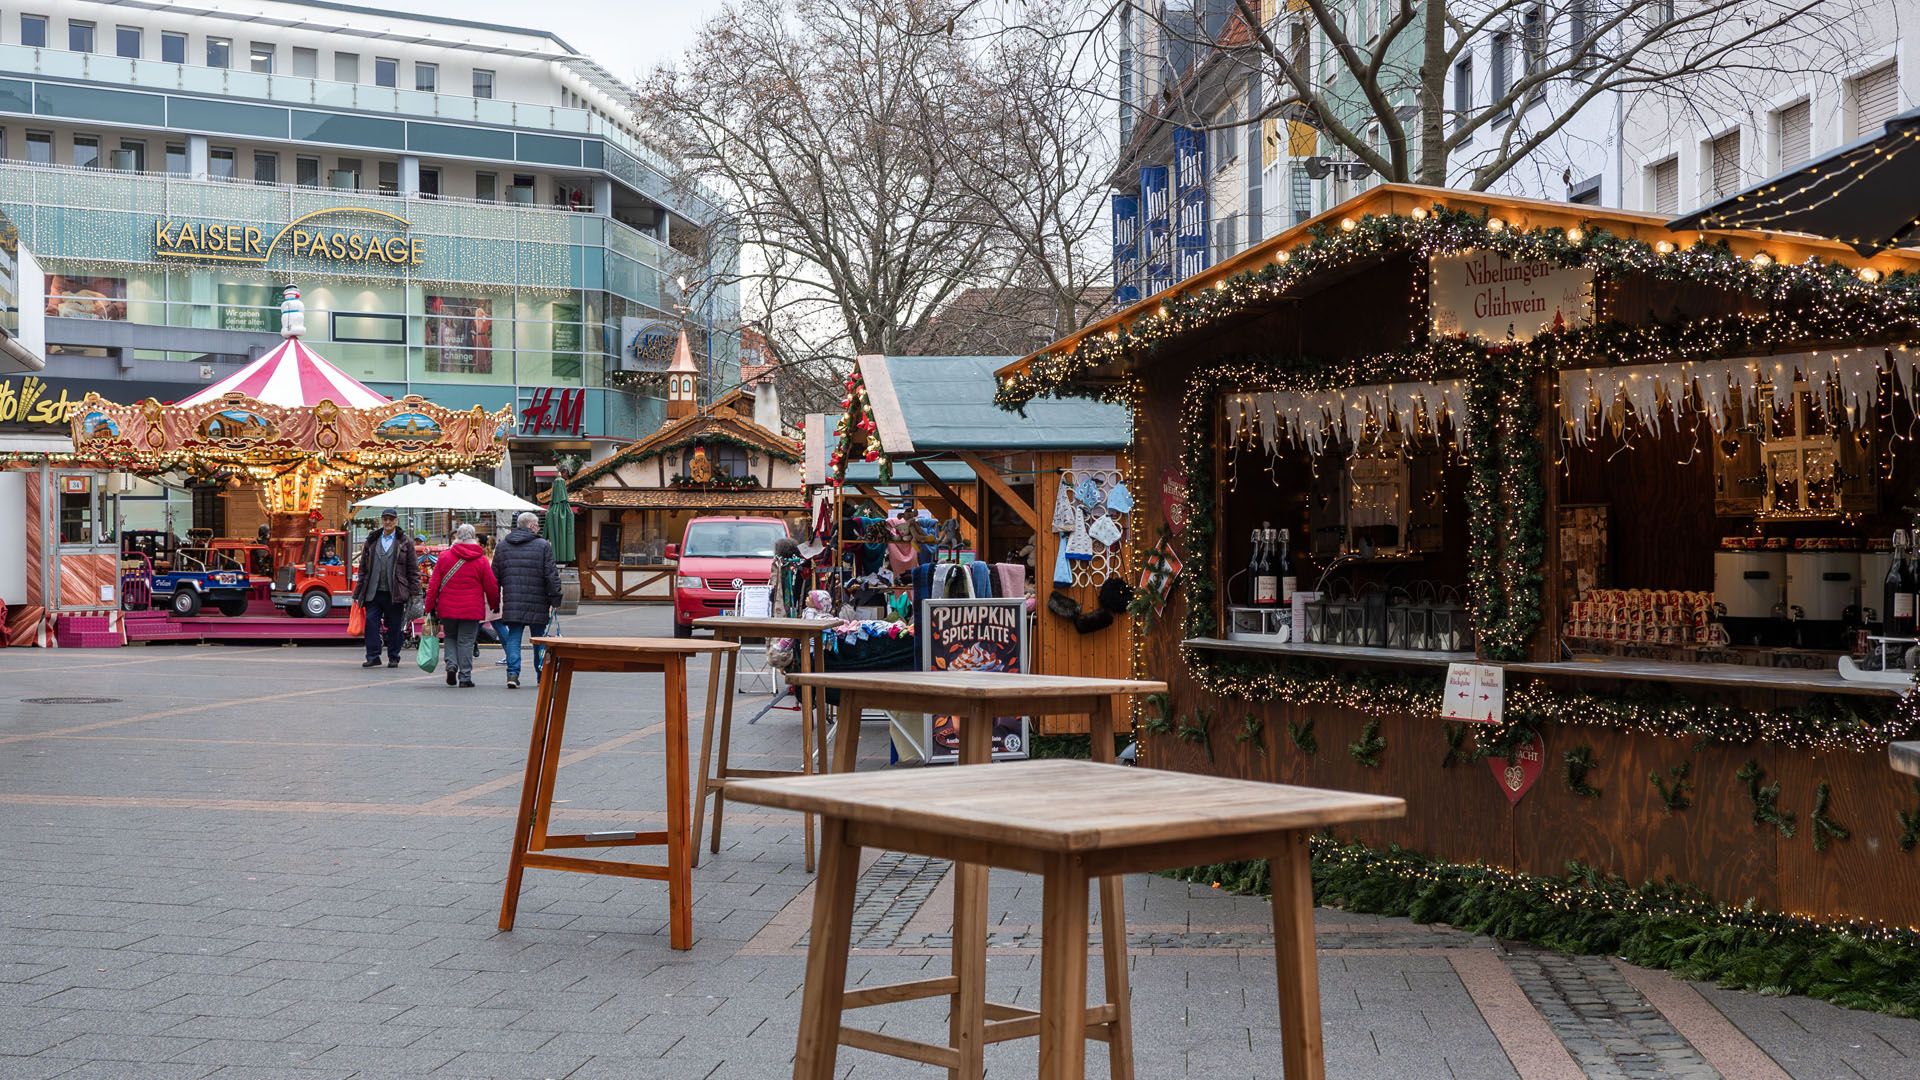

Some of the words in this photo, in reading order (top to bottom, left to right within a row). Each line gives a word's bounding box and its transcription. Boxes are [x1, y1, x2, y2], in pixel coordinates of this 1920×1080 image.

[155, 220, 262, 253] KAISER
[291, 229, 425, 264] PASSAGE
[1464, 255, 1555, 287] Nibelungen-
[1474, 287, 1546, 319] Glühwein
[225, 309, 238, 317] Wir
[239, 309, 260, 319] geben
[225, 317, 247, 325] deiner
[248, 318, 265, 326] alten
[444, 335, 464, 343] wear
[444, 352, 473, 361] change
[635, 346, 676, 361] PASSAG
[521, 387, 585, 436] H&M
[933, 606, 1015, 631] PUMPKIN
[942, 625, 975, 645] SPICE
[977, 625, 1010, 644] LATTE
